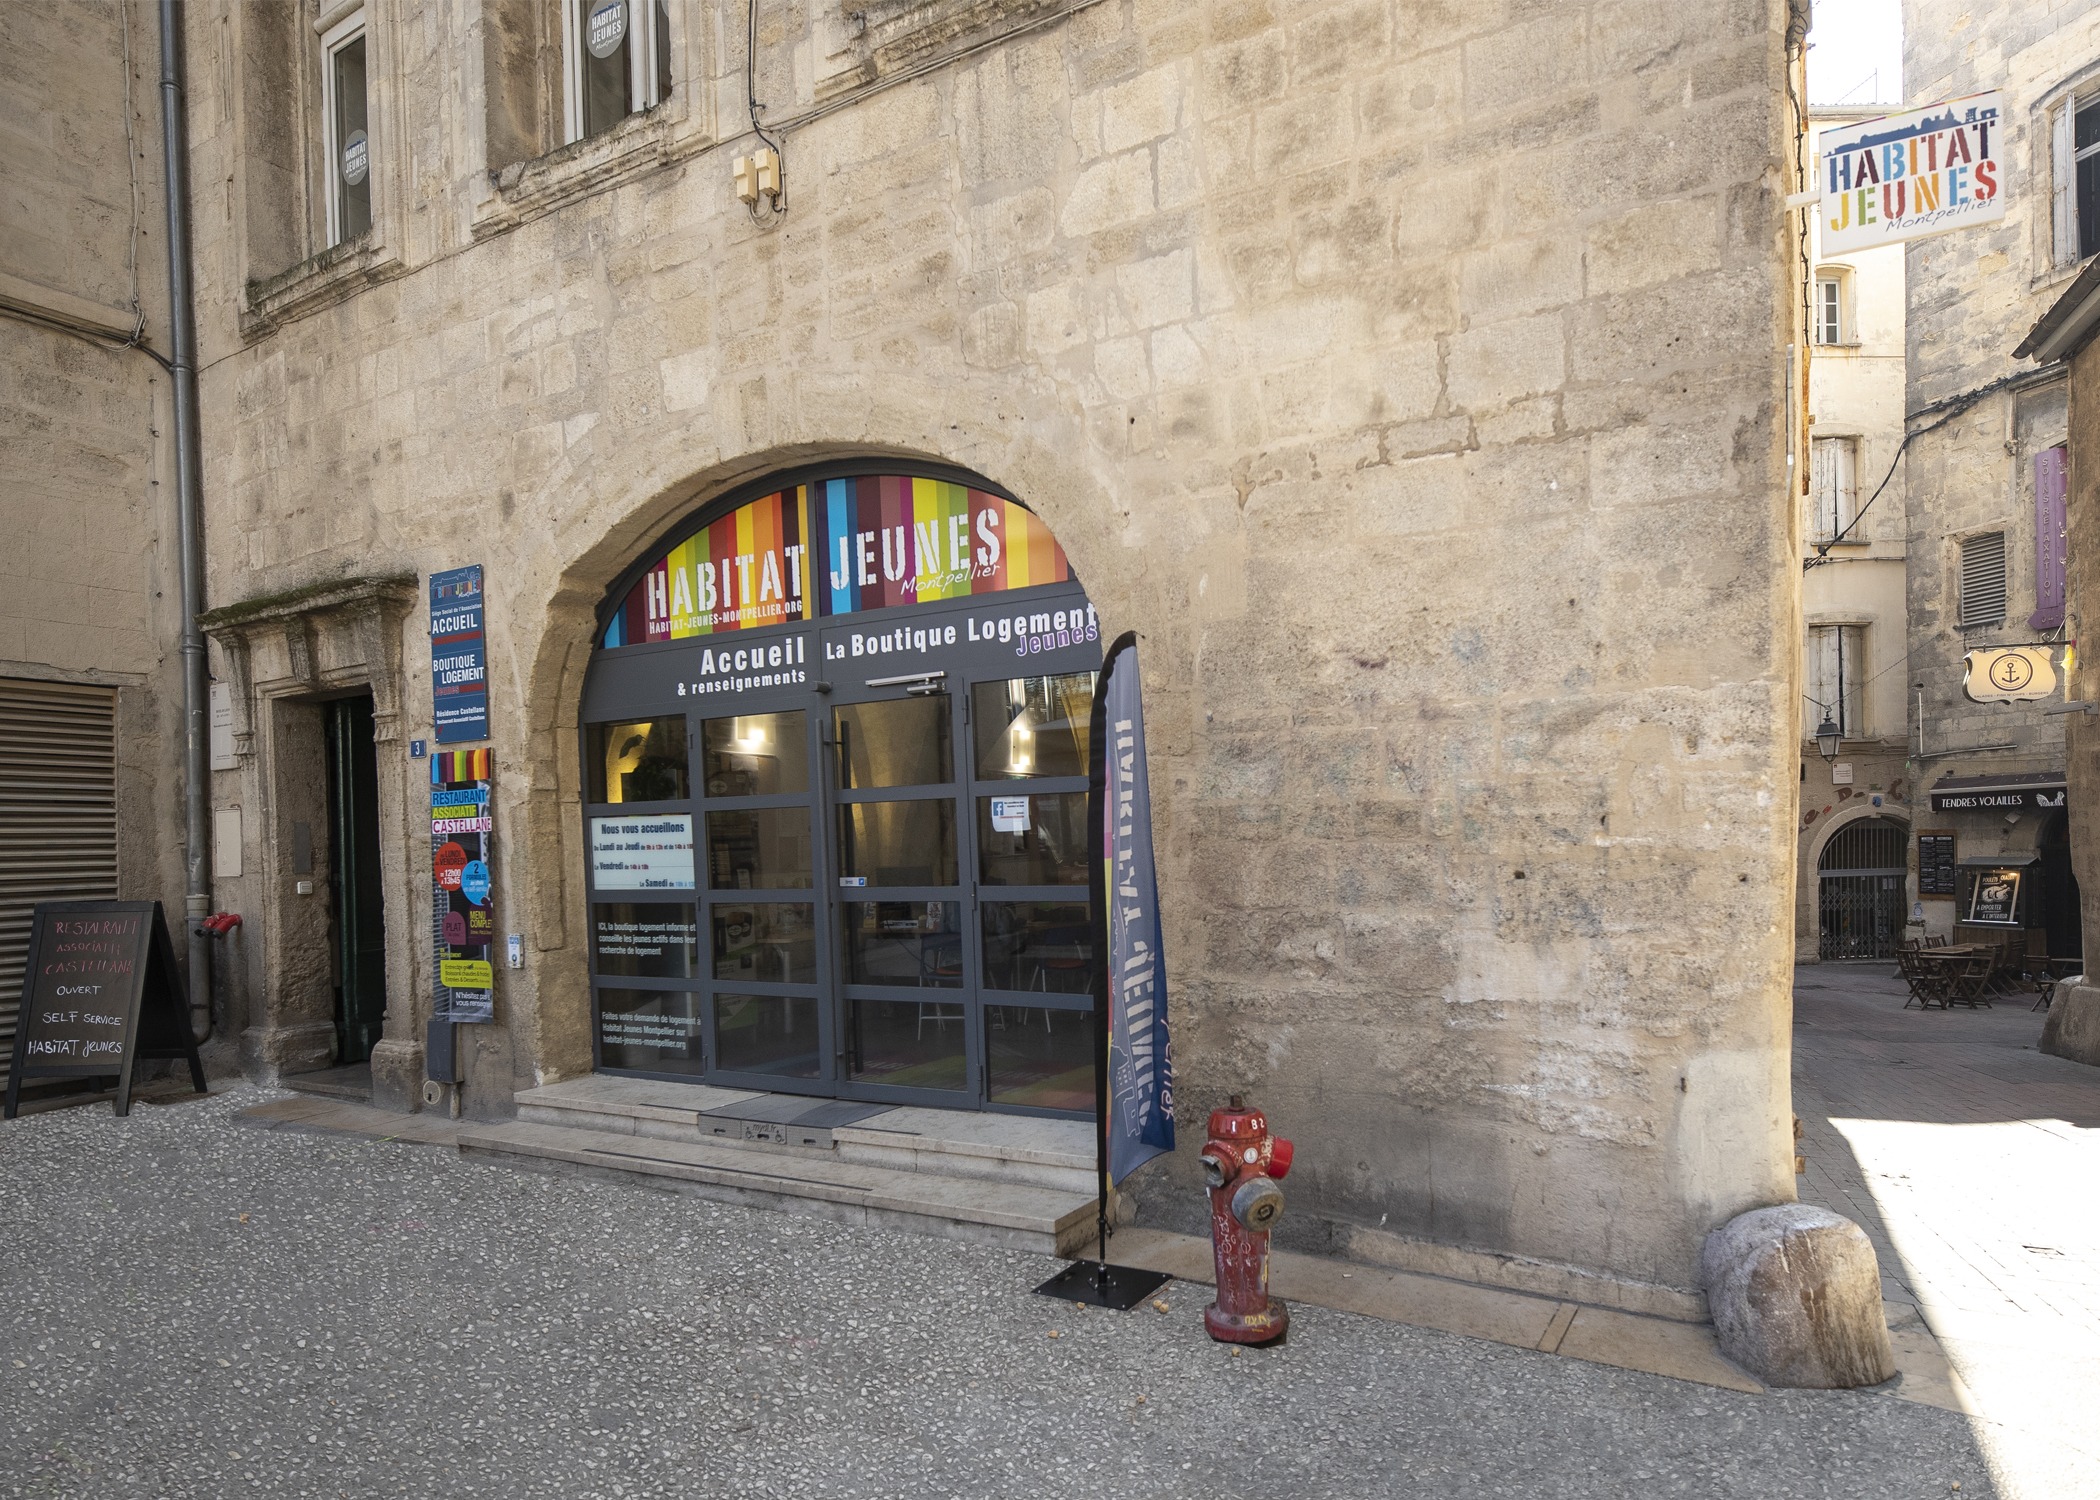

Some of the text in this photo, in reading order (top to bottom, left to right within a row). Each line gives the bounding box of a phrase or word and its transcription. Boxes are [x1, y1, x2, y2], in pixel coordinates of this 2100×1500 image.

[591, 4, 621, 30] HABITAT
[591, 20, 621, 44] JEUNES
[345, 140, 366, 161] HABITAT
[1829, 119, 1995, 194] HABITAT
[345, 153, 367, 174] JEUNES
[1830, 160, 1997, 231] JEUNES
[1885, 195, 1997, 233] Montpellier
[830, 508, 1000, 590] JEUNES
[2043, 507, 2051, 598] RELAXATION
[648, 544, 805, 620] HABITAT
[900, 563, 1001, 595] Montpellier
[432, 613, 478, 634] ACCUEIL
[826, 602, 1096, 660] La Boutique Logement
[1016, 623, 1098, 656] Jeunes
[433, 654, 475, 672] BOUTIQUE
[701, 636, 804, 675] Accueil
[442, 667, 485, 684] LOGEMENT
[678, 669, 806, 696] & renseignements
[435, 685, 460, 696] Jeunes
[436, 706, 485, 717] Résidence Castellane
[415, 742, 420, 755] 3
[432, 789, 486, 805] RESTAURANT
[1942, 795, 2022, 808] TENDRES VOLAILLES
[432, 805, 477, 818] ASSOCIATIF
[433, 818, 491, 833] CASTELLANE
[601, 822, 685, 834] Nous vous accueillons
[600, 843, 615, 851] Lundi
[625, 842, 640, 850] Jeudi
[473, 863, 479, 874] 2
[600, 862, 623, 870] Vendredi
[645, 879, 668, 887] Samedi
[470, 910, 486, 919] MENU
[446, 922, 461, 931] PLAT
[470, 919, 492, 928] COMPLE
[608, 922, 613, 930] la
[613, 922, 638, 932] boutique
[639, 923, 665, 932] logement
[666, 923, 688, 931] informe
[689, 923, 696, 931] et
[598, 934, 696, 944] conseille les jeunes actifs dans leur
[599, 946, 661, 956] recherche de logement
[57, 985, 102, 996] OUVERT
[42, 1011, 122, 1026] SELF SERVICE
[602, 1011, 618, 1020] Faites
[634, 1013, 660, 1022] demande
[661, 1014, 668, 1022] de
[669, 1014, 696, 1025] logement
[602, 1023, 686, 1036] Habitat Jeunes Montpellier sur
